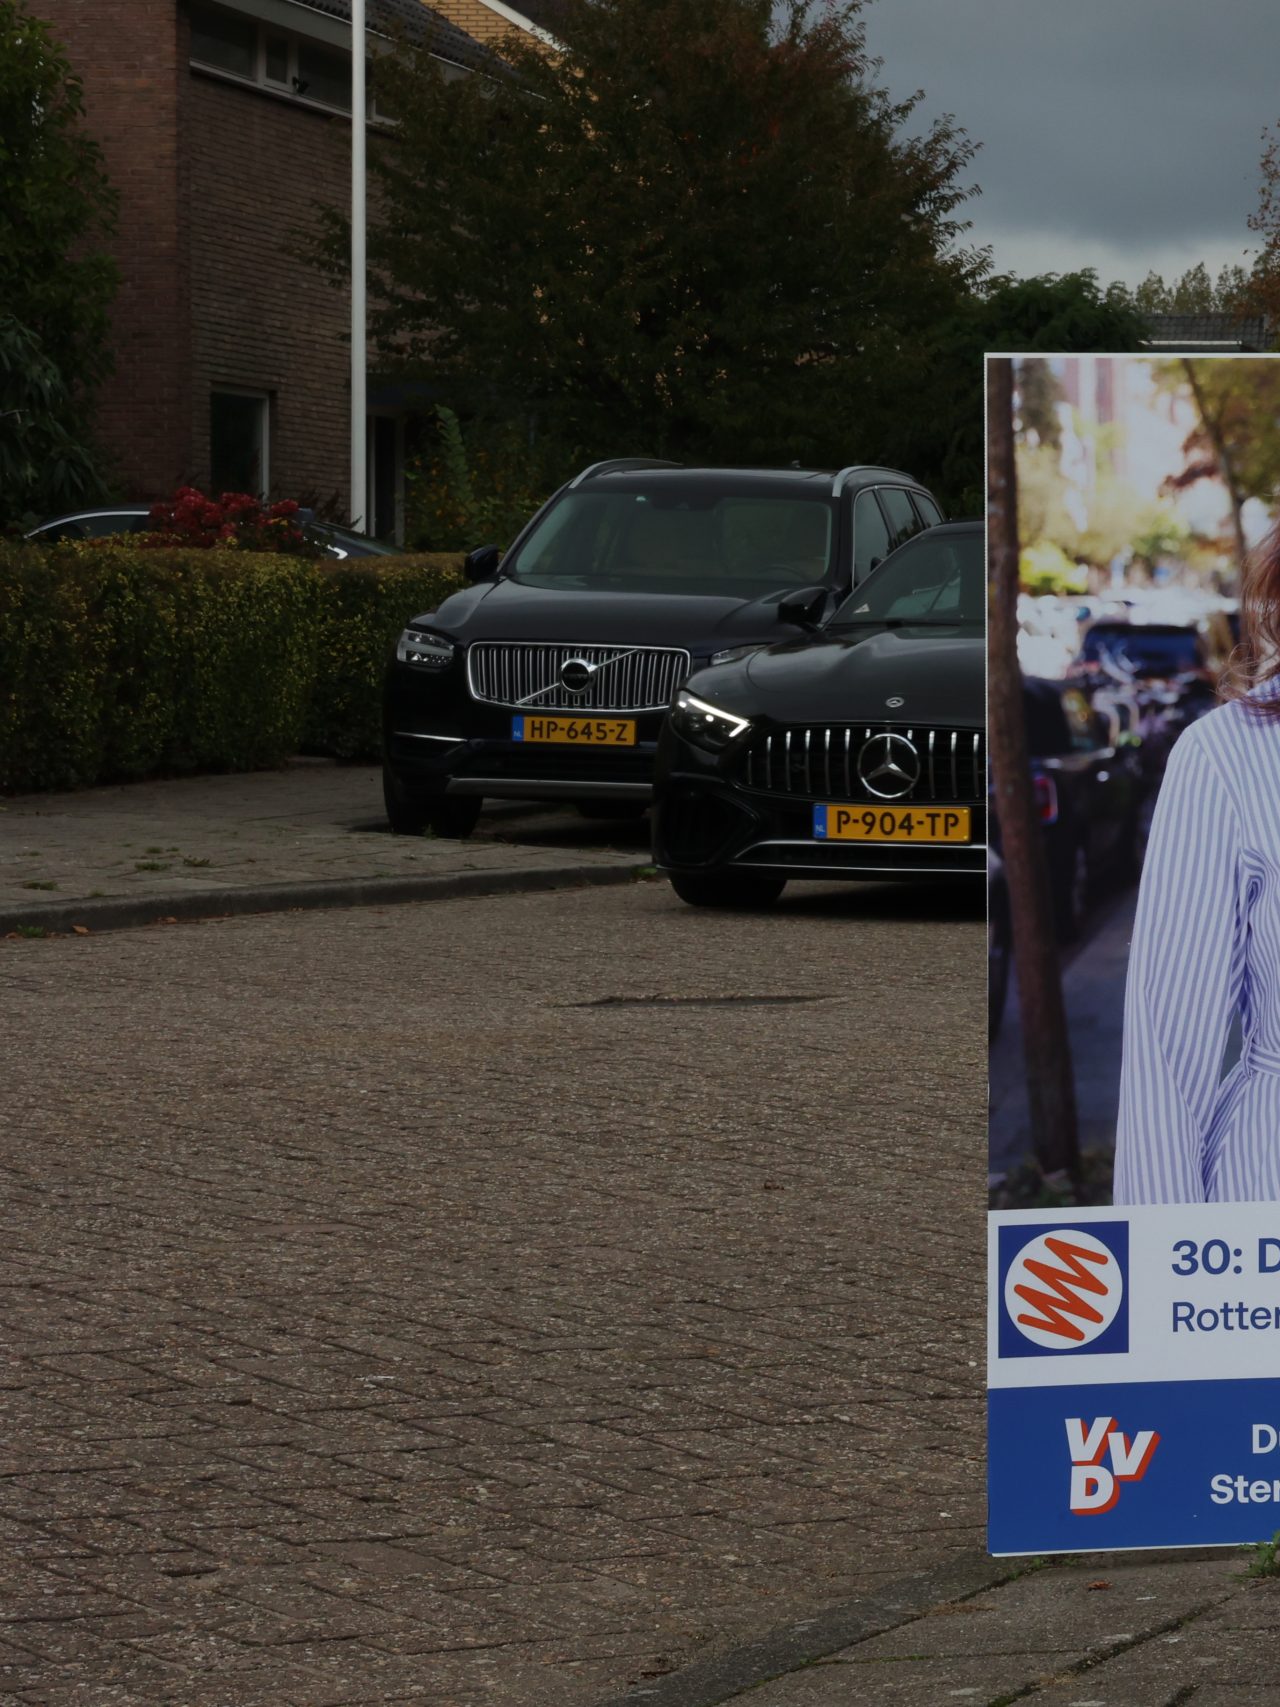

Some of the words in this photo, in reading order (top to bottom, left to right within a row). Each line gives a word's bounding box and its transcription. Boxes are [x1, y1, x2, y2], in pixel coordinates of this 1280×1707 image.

[531, 720, 628, 742] HP-645-Z
[837, 810, 959, 836] P-904-TP
[1171, 1239, 1242, 1275] 30:
